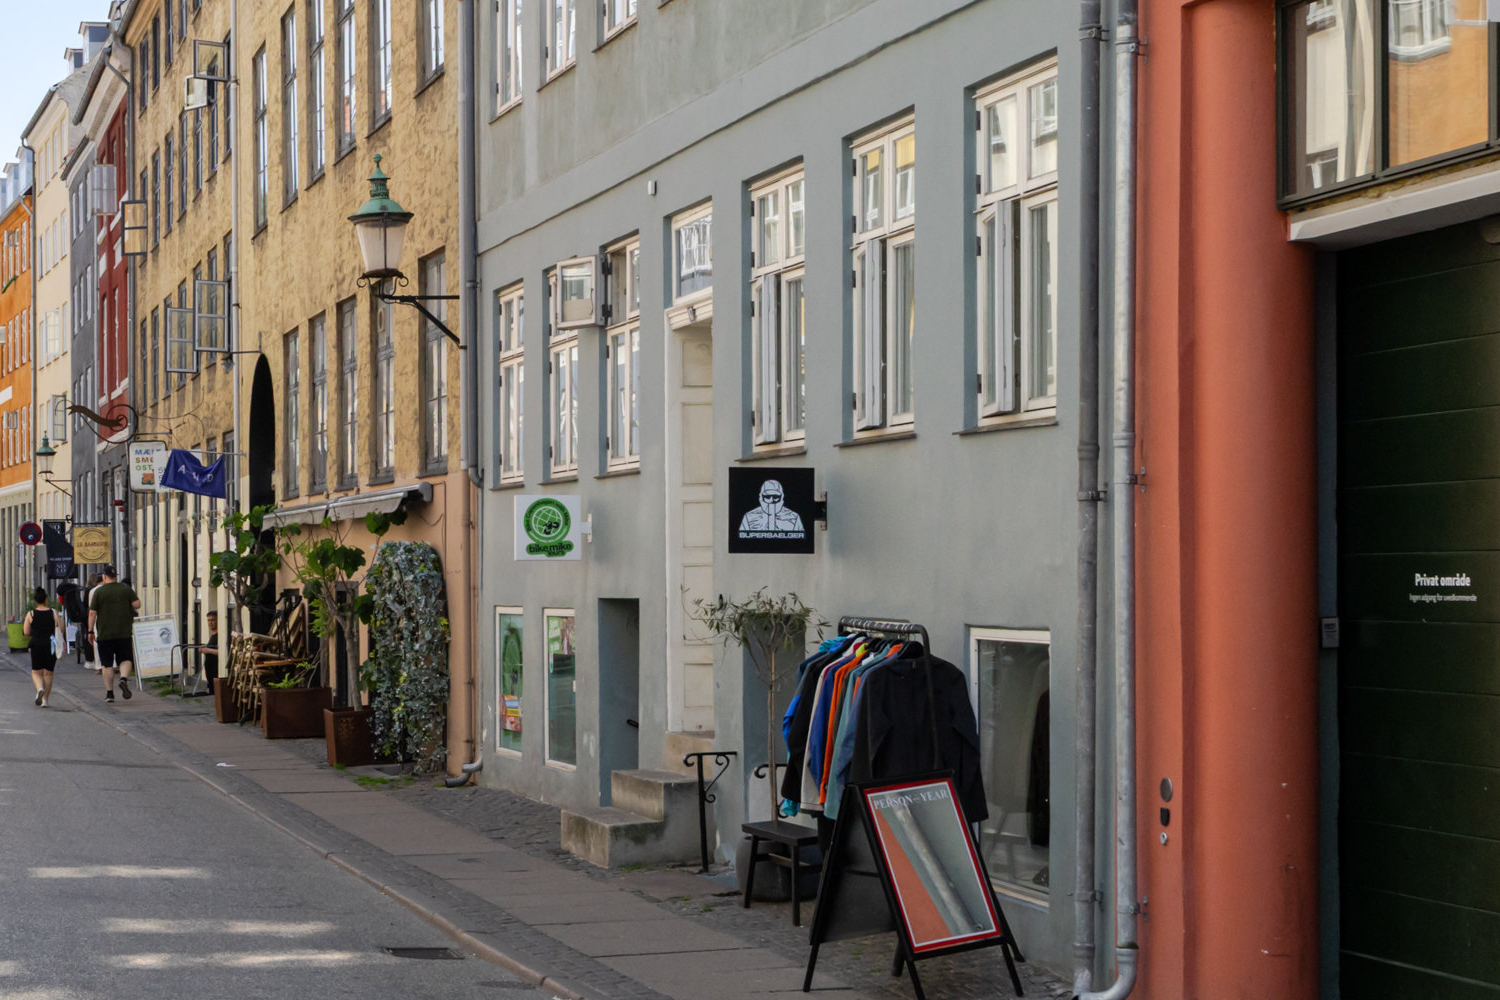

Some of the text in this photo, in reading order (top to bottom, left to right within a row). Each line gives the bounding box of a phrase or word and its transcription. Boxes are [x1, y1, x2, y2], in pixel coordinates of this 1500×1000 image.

[528, 542, 572, 553] bike mike
[1415, 573, 1470, 586] Privat område
[874, 796, 913, 809] PERSON
[920, 789, 949, 801] YEAR
